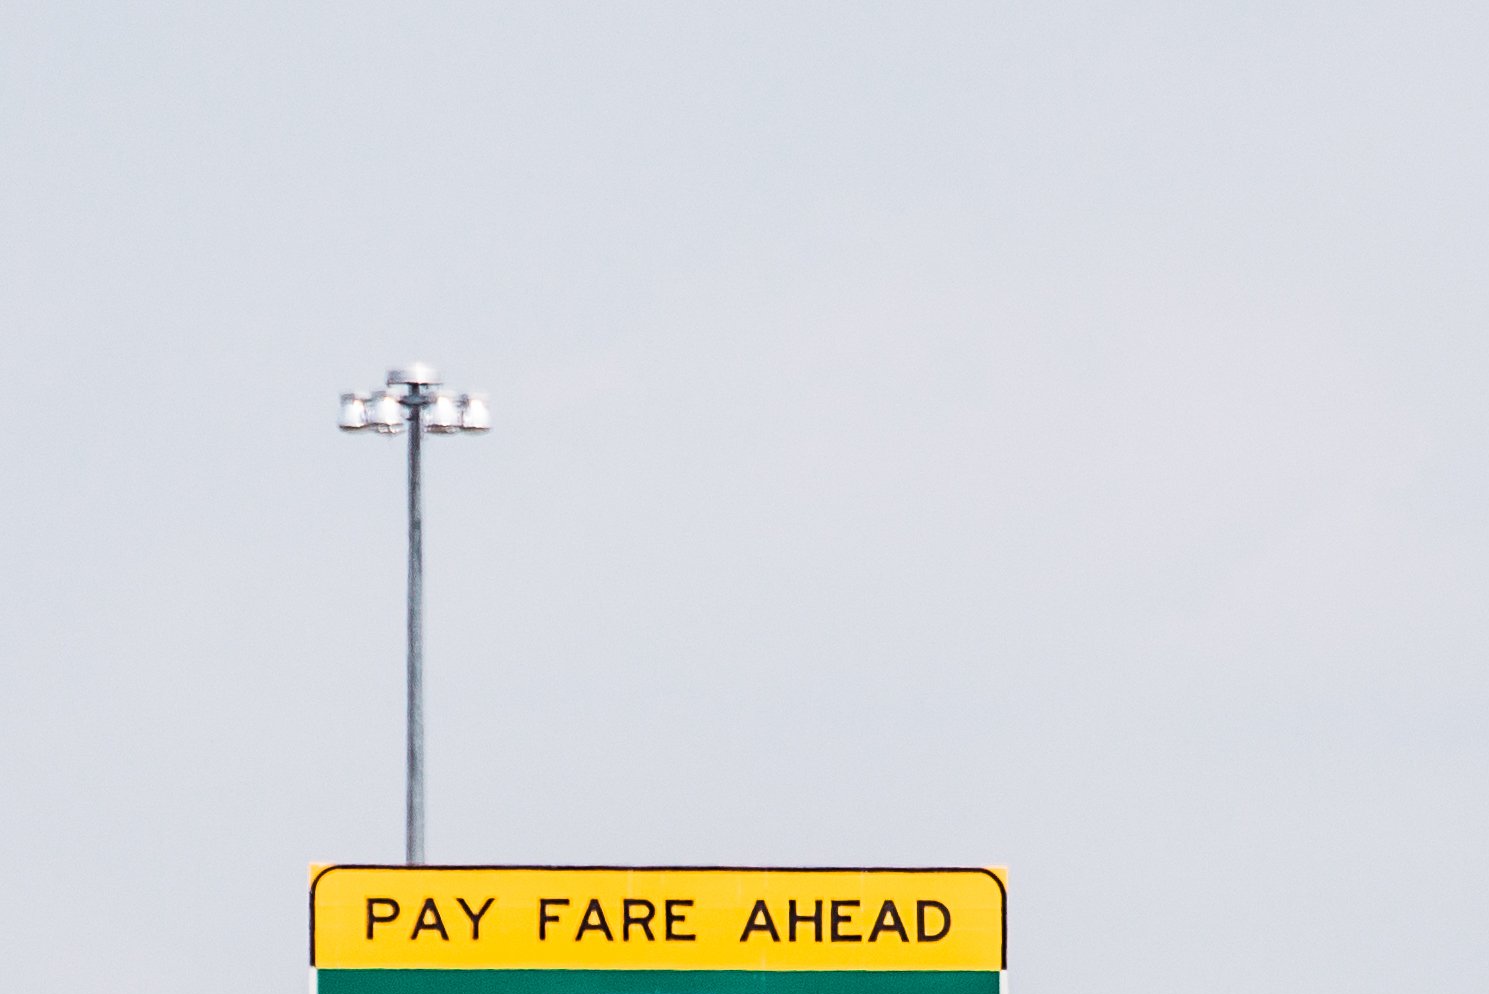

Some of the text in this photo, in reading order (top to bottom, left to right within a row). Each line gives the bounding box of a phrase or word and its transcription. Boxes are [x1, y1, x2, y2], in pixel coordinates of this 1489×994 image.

[367, 898, 951, 943] PAY FARE AHEAD
